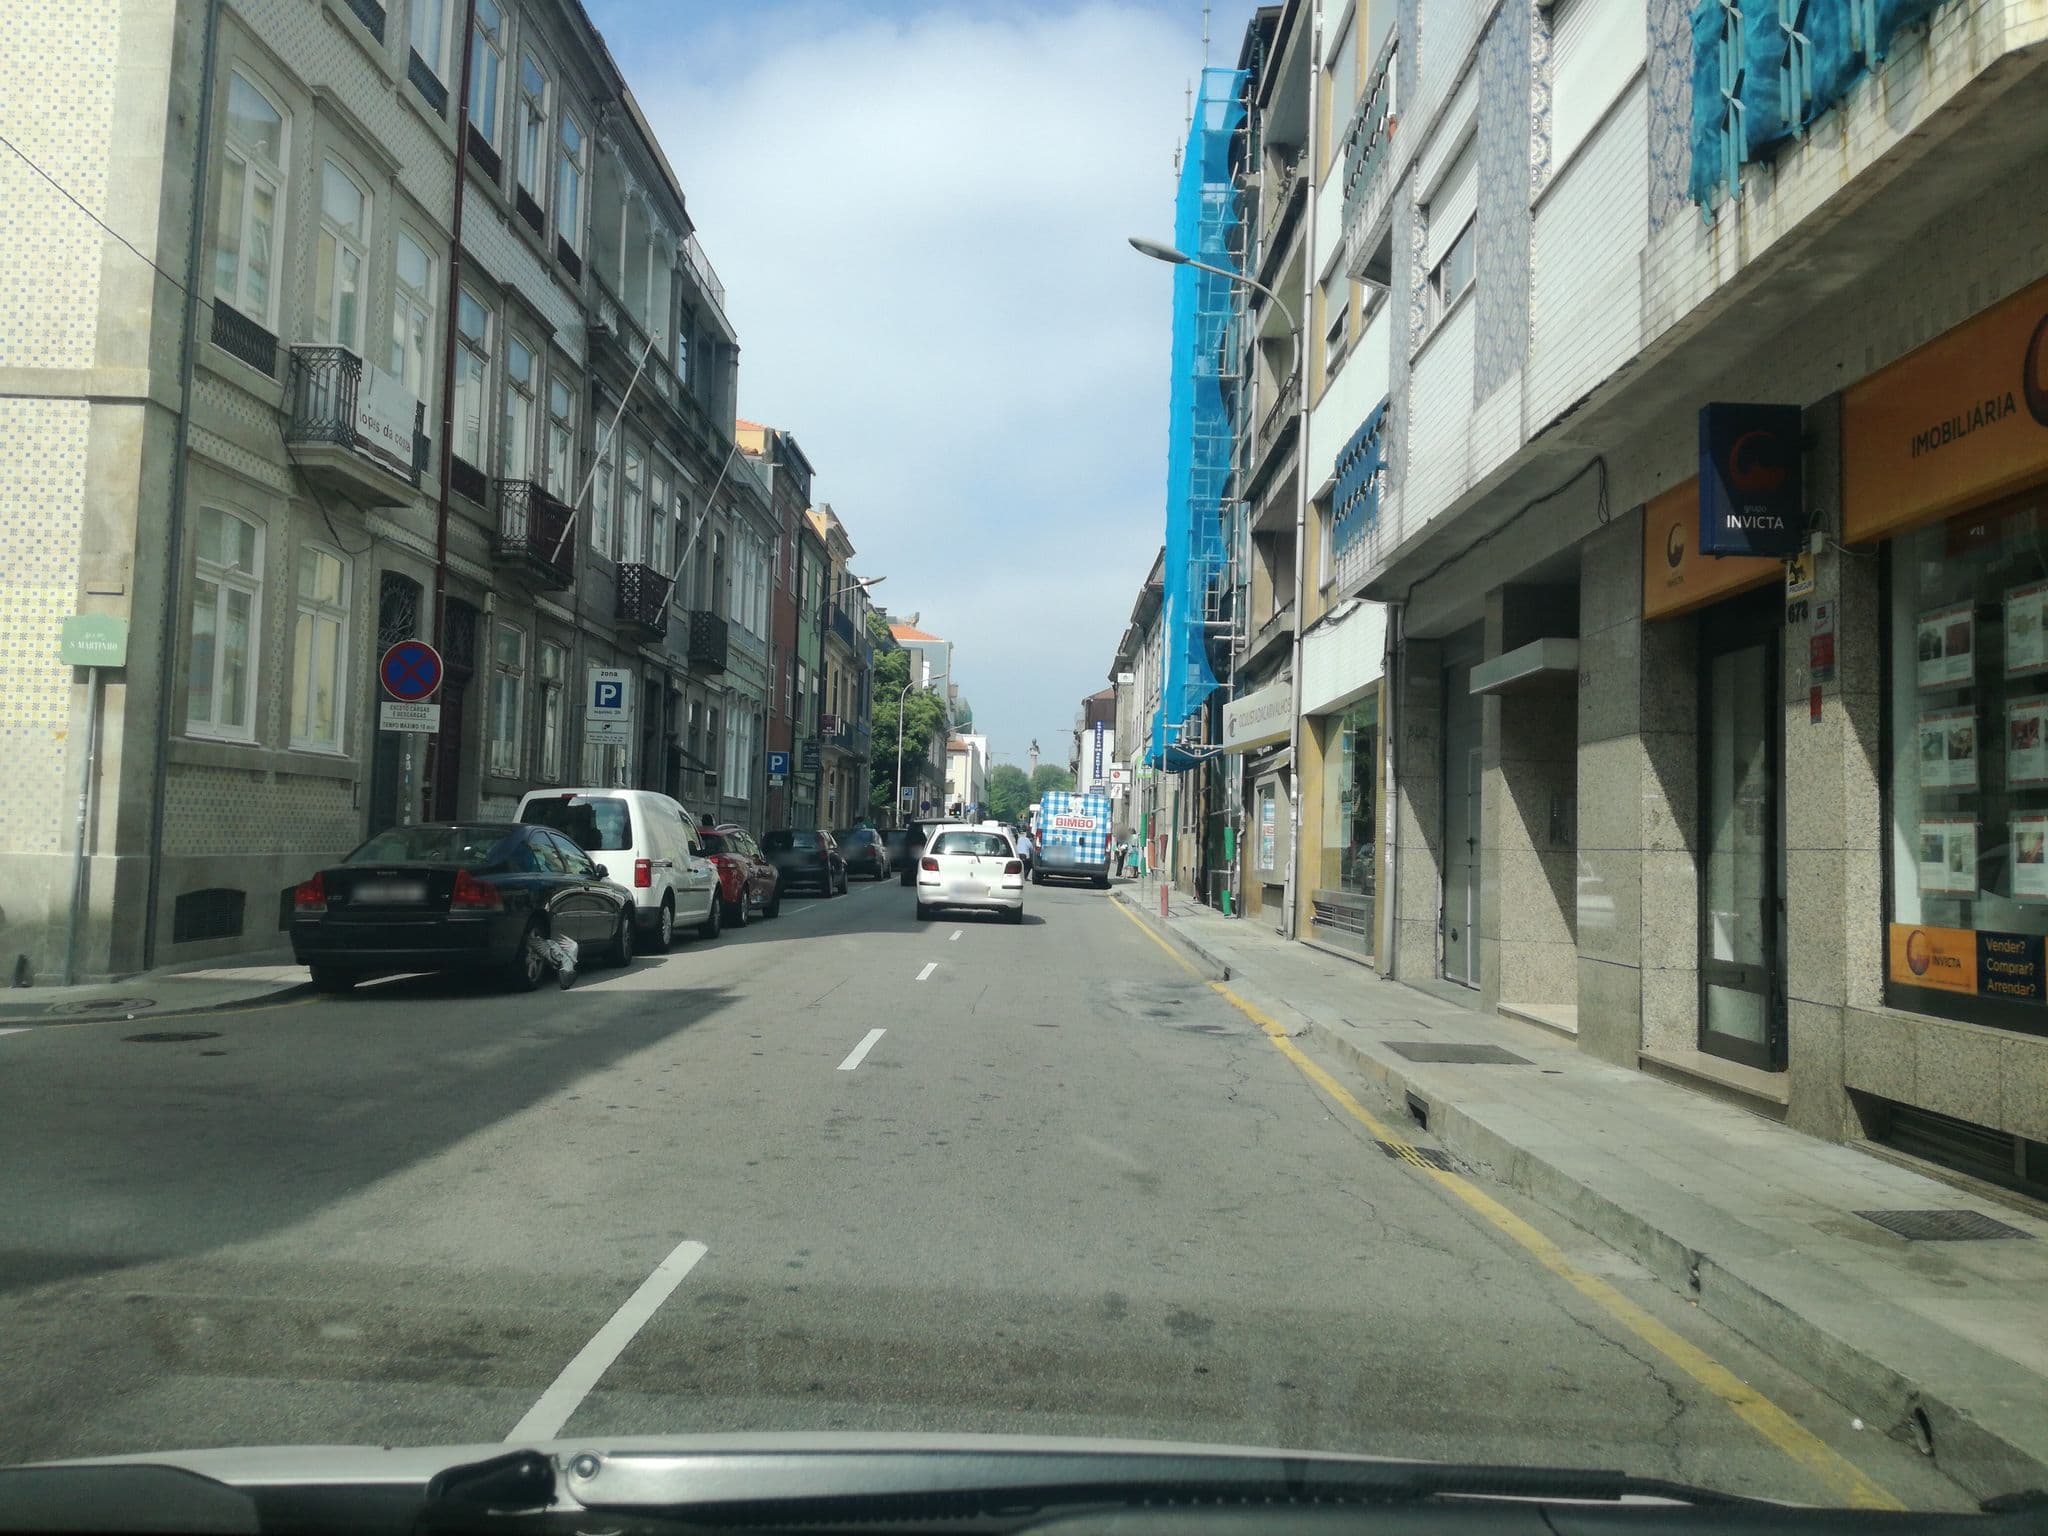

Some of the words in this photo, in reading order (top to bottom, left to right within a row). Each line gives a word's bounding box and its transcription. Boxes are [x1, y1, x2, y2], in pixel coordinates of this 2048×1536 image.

[1911, 391, 2017, 459] IMOBILIÁRIA
[1726, 514, 1785, 529] INVICTA
[600, 684, 617, 705] P
[770, 754, 784, 771] P
[1055, 817, 1094, 829] BIMBO
[1986, 938, 2025, 954] Vender?
[1986, 957, 2035, 977] Comprar?
[1987, 978, 2036, 997] Arrendar?
